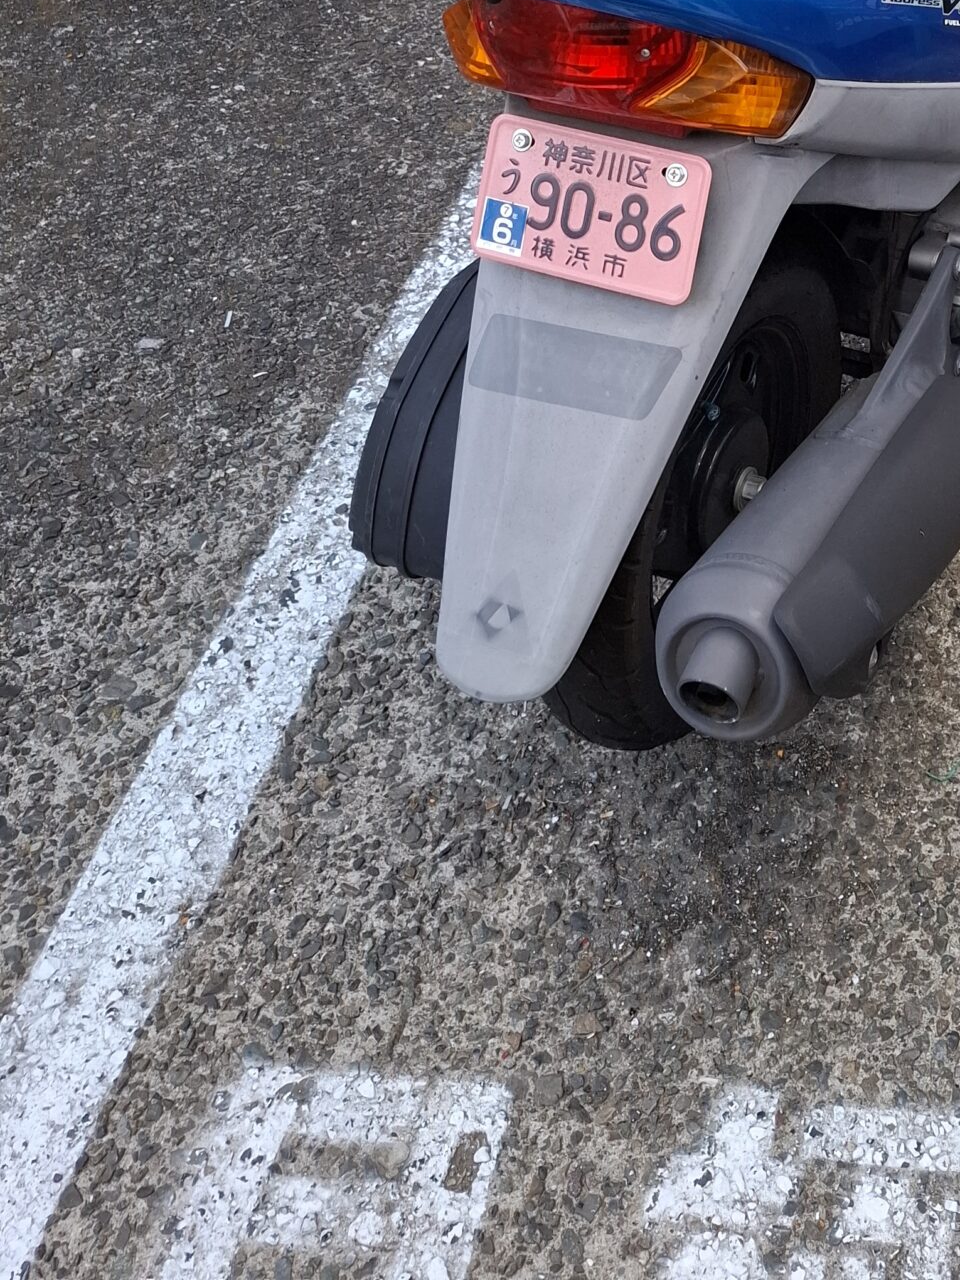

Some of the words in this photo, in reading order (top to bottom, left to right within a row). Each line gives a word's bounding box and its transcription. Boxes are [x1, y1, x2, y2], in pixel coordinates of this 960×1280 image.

[542, 137, 652, 189] 神奈川区
[501, 158, 521, 195] う
[526, 172, 686, 262] 90-86
[531, 234, 627, 279] 横浜市
